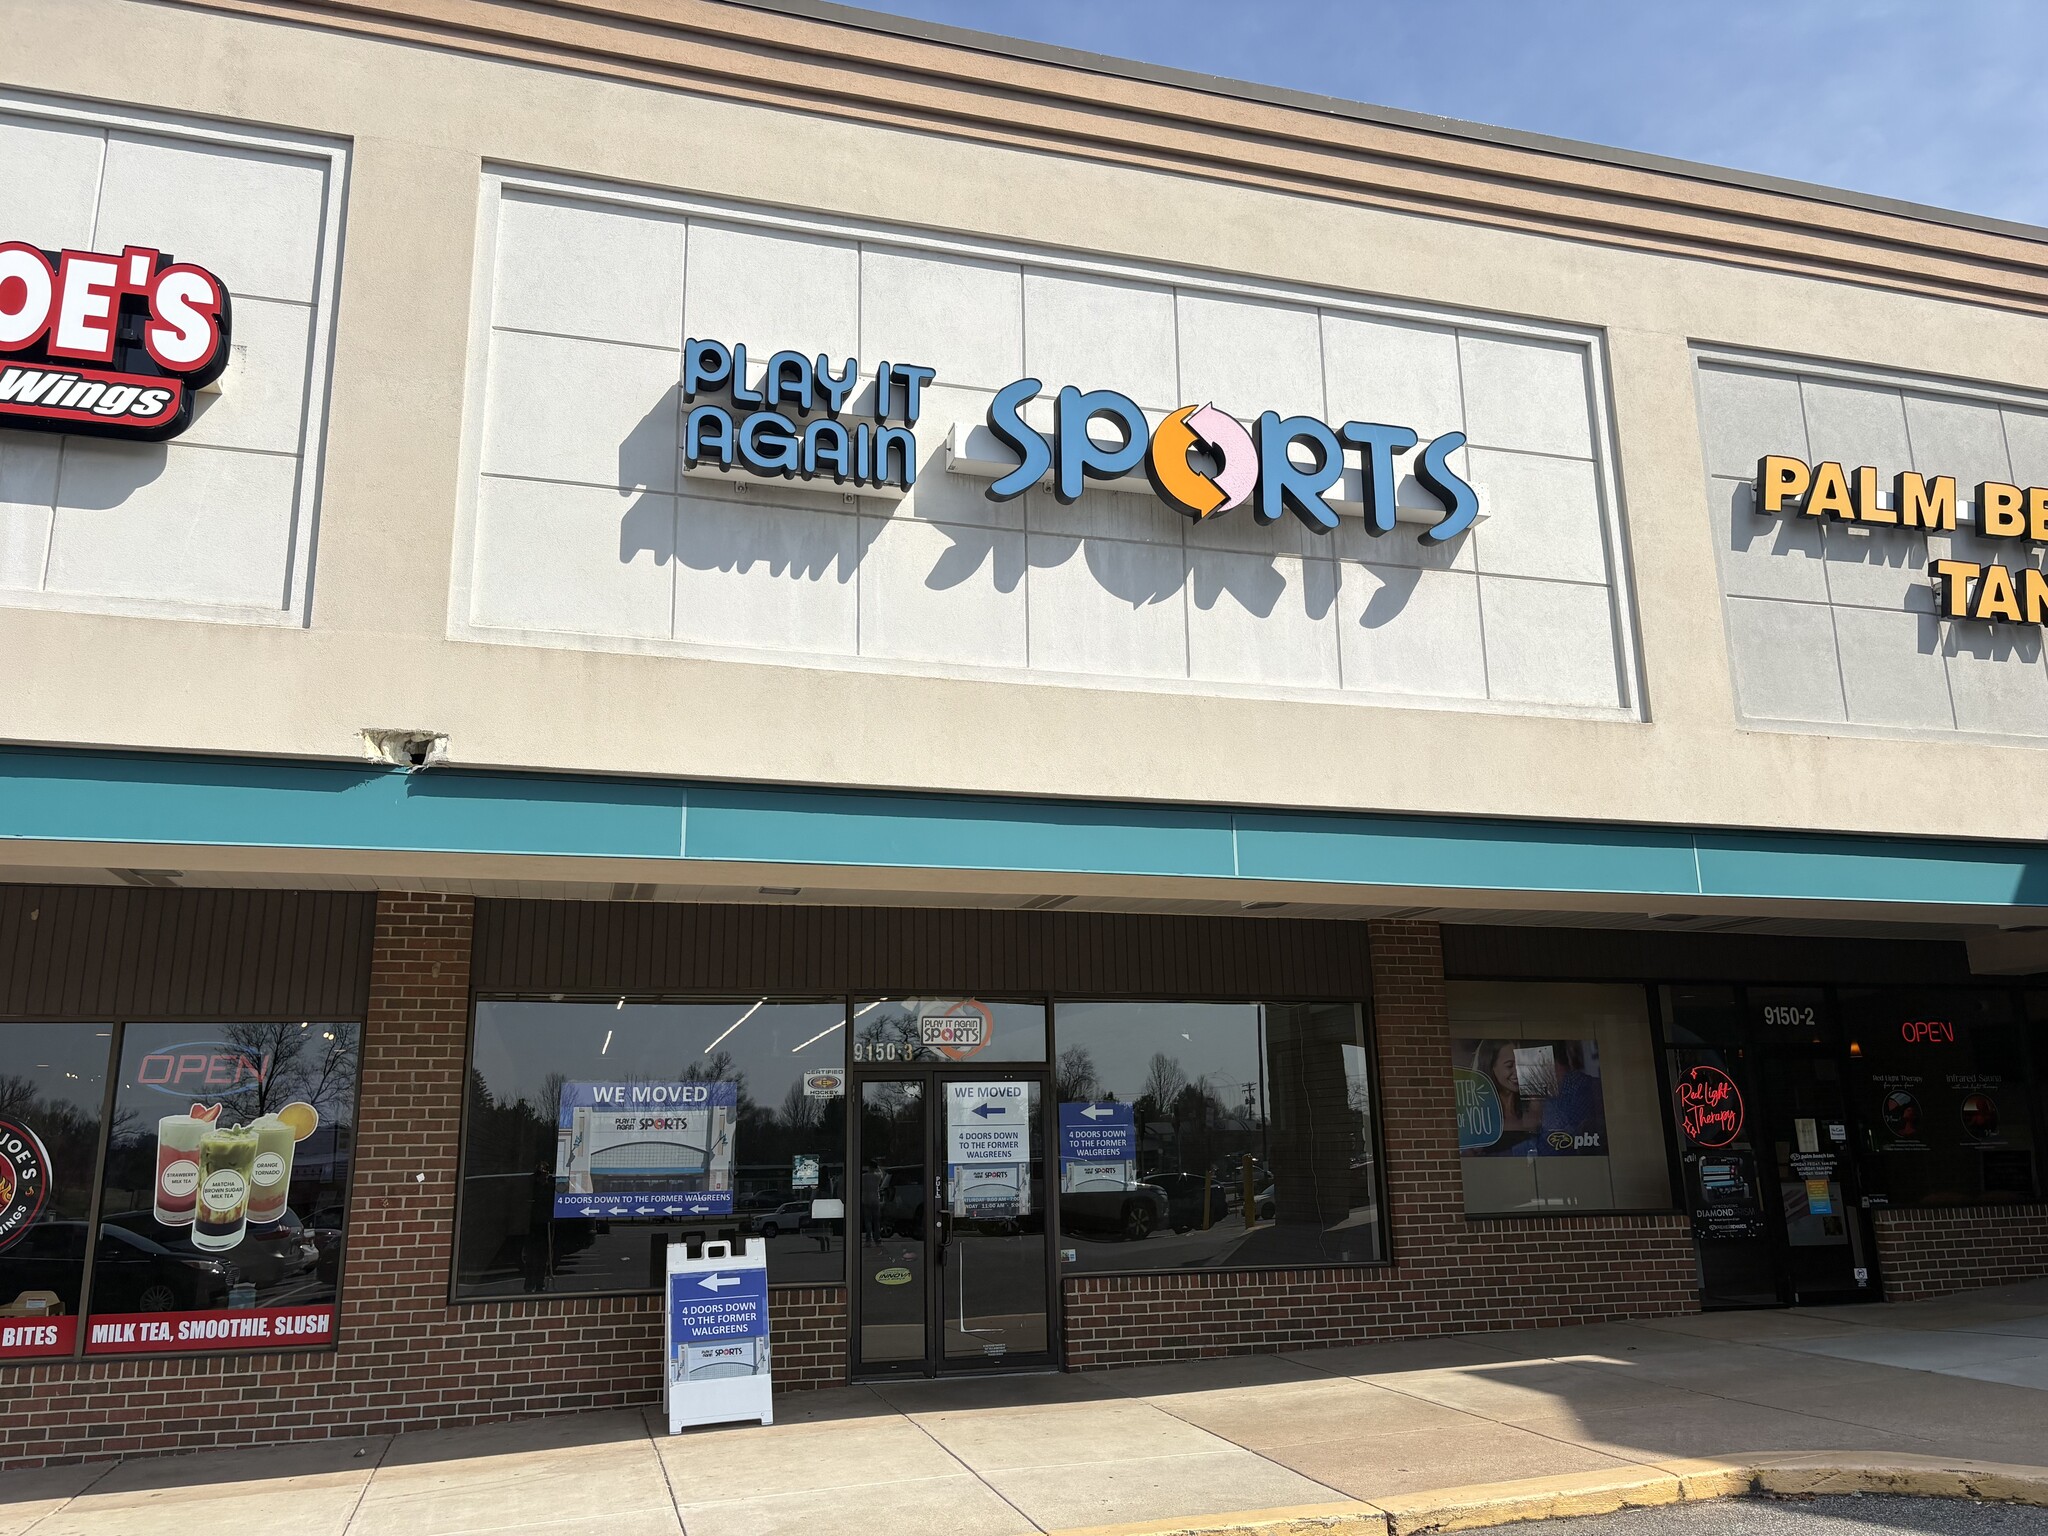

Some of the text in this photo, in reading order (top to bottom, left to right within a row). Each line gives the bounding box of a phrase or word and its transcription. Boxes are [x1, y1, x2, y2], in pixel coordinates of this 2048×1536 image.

[685, 337, 936, 426] PLAY IT
[0, 369, 172, 417] Wings
[685, 404, 917, 489] AGAIN
[986, 377, 1479, 544] SPORTS
[1758, 455, 1957, 531] PALM
[1764, 1006, 1815, 1026] 9150-2
[925, 1019, 978, 1028] PLAY IT AGAIN
[924, 1027, 979, 1043] SPORTS
[1902, 1021, 1954, 1042] OPEN
[138, 1054, 269, 1085] OPEN
[1872, 1074, 1923, 1083] Red Light Therapy
[1946, 1073, 2002, 1083] Infrared Sauna
[593, 1086, 708, 1103] WE MOVED
[954, 1086, 1022, 1098] WE MOVED
[1676, 1082, 1732, 1107] Red Light
[639, 1117, 688, 1131] SPORTS
[1466, 1106, 1492, 1135] YOU
[1686, 1104, 1736, 1134] Therapy
[959, 1132, 964, 1140] 4
[966, 1132, 992, 1140] DOORS
[1076, 1130, 1101, 1138] DOORS
[1102, 1130, 1126, 1138] DOWN
[1574, 1132, 1601, 1150] pbt
[959, 1141, 1019, 1149] TO THE FORMER
[1081, 1139, 1095, 1147] THE
[1096, 1139, 1127, 1147] FORMER
[0, 1133, 37, 1180] JOE'S
[966, 1150, 1012, 1158] WALGREENS
[1076, 1148, 1121, 1157] WALGREENS
[984, 1171, 1008, 1179] SPORTS
[1094, 1167, 1116, 1175] SPORTS
[564, 1196, 593, 1204] DOORS
[594, 1196, 620, 1204] DOWN
[622, 1195, 633, 1203] TO
[635, 1195, 649, 1203] THE
[651, 1194, 683, 1203] FORMER
[684, 1193, 731, 1202] WALGREENS
[879, 1272, 911, 1280] INNOVA
[682, 1302, 756, 1316] 4 DOORS DOWN
[682, 1312, 757, 1326] TO THE FORMER
[2, 1325, 58, 1347] BITES
[91, 1314, 331, 1344] MILK TEA, SMOOTHIE, SLUSH
[691, 1325, 749, 1336] WALGREENS
[714, 1347, 743, 1357] SPORTS
